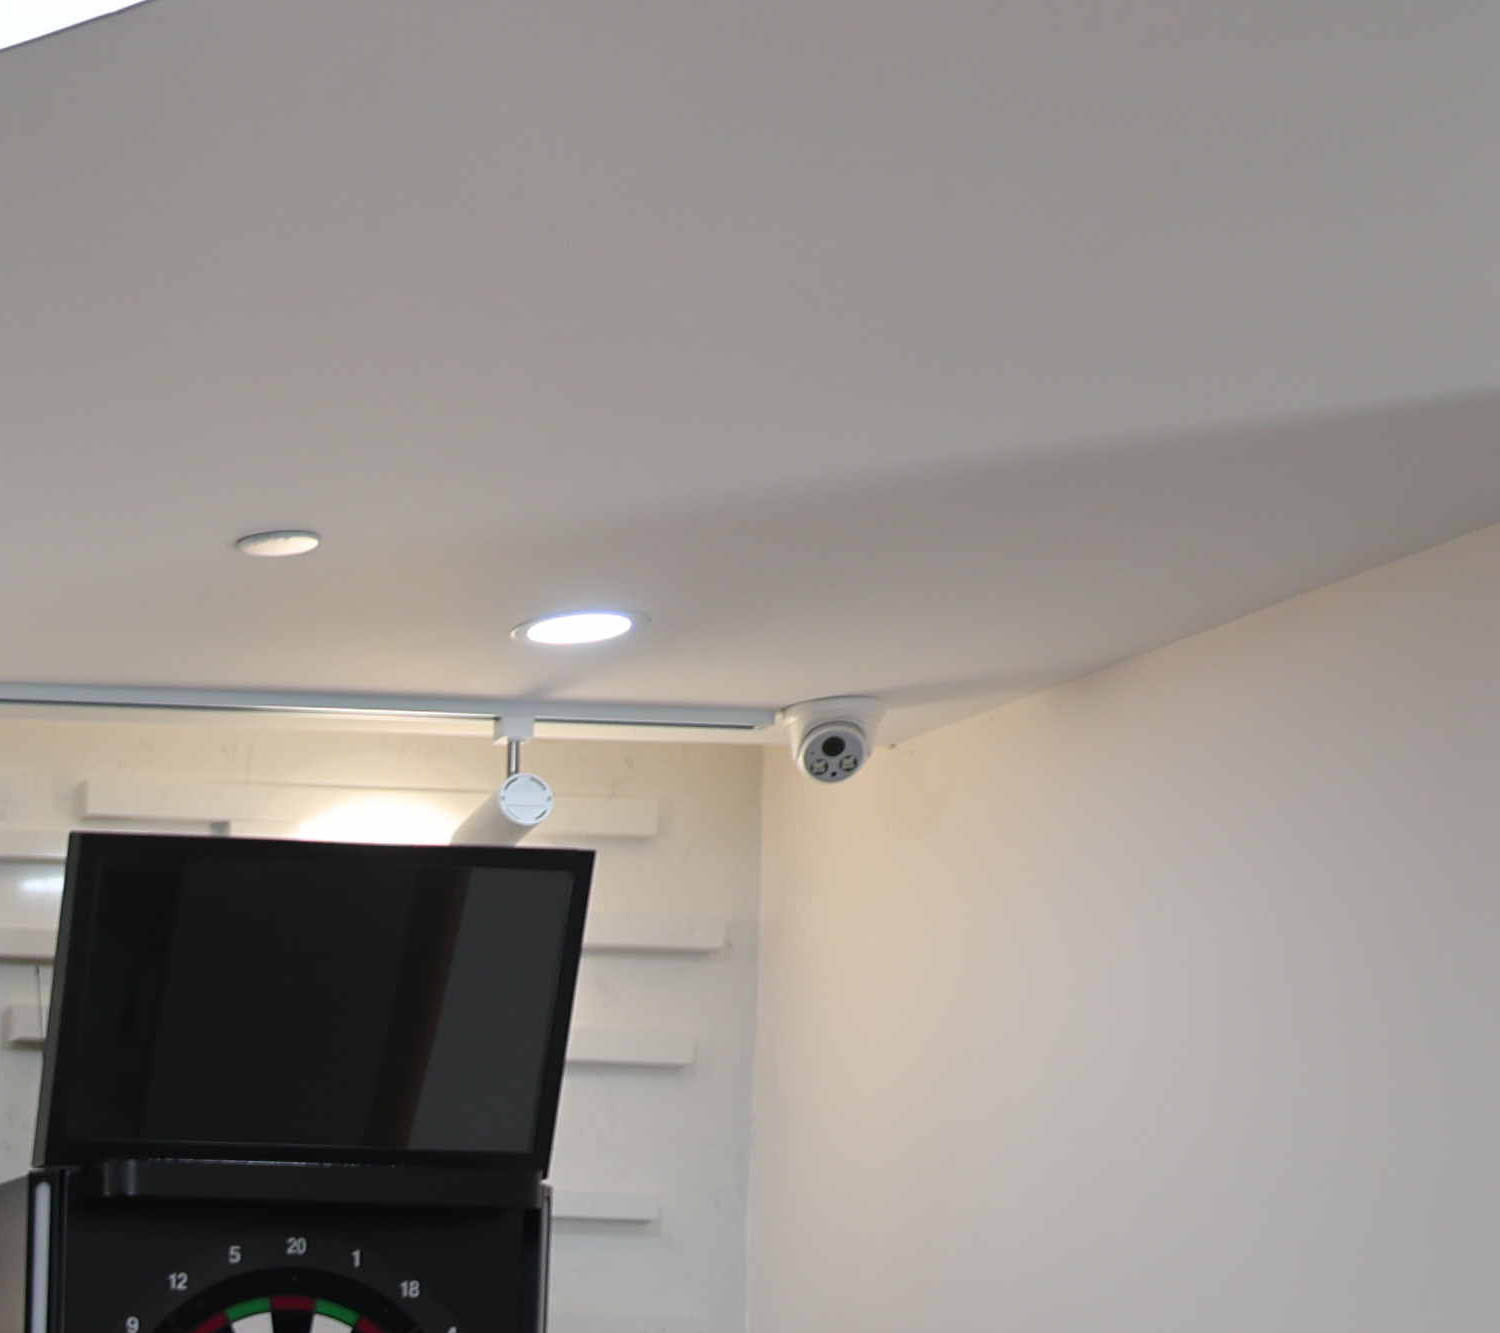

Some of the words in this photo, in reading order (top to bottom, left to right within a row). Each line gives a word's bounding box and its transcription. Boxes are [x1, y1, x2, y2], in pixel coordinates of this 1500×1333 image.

[287, 1238, 306, 1254] 20
[229, 1246, 241, 1263] 5
[352, 1249, 361, 1266] 1
[169, 1272, 188, 1290] 12
[400, 1281, 420, 1297] 18
[127, 1317, 139, 1333] 9
